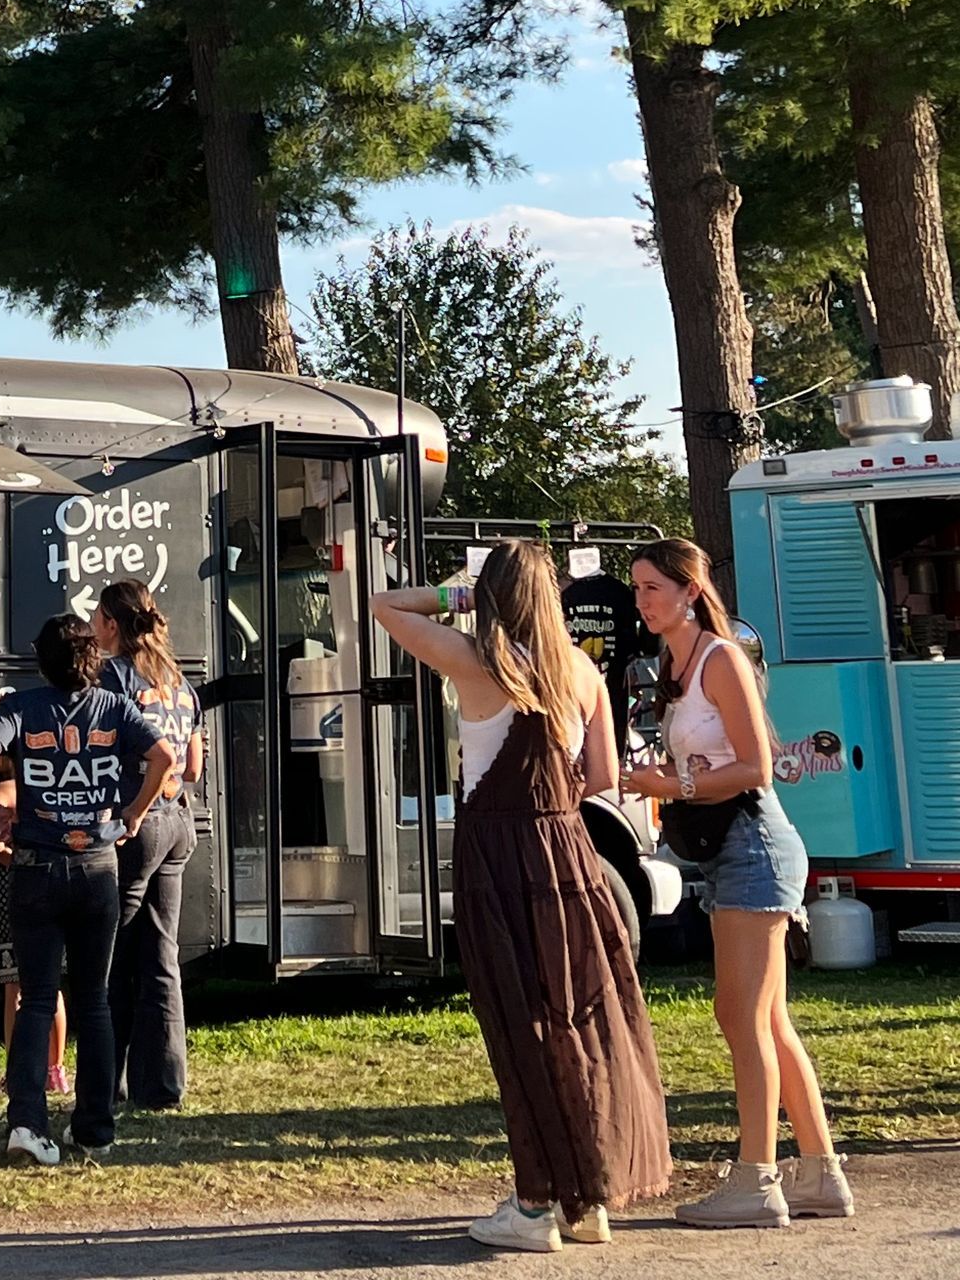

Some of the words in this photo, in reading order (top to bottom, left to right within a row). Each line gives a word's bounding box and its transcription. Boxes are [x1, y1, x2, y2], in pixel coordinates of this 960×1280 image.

[55, 488, 170, 536] Order
[47, 541, 145, 582] Here
[23, 755, 120, 788] BAR
[42, 787, 106, 806] CREW
